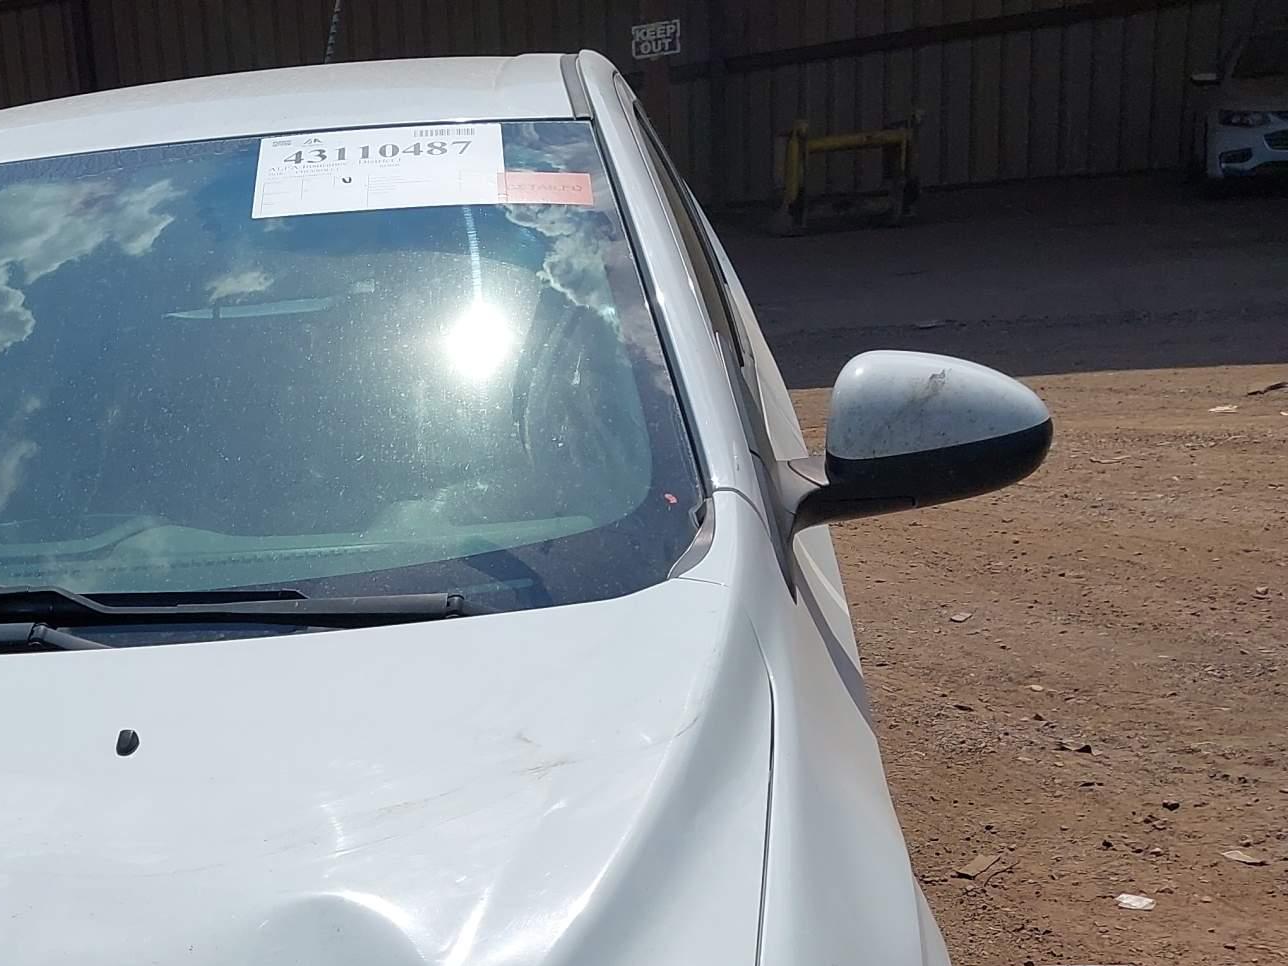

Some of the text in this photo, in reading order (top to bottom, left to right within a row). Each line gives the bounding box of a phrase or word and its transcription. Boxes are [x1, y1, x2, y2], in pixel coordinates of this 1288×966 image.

[635, 24, 675, 41] KEEP
[640, 39, 672, 53] OUT
[283, 140, 472, 165] 43110487
